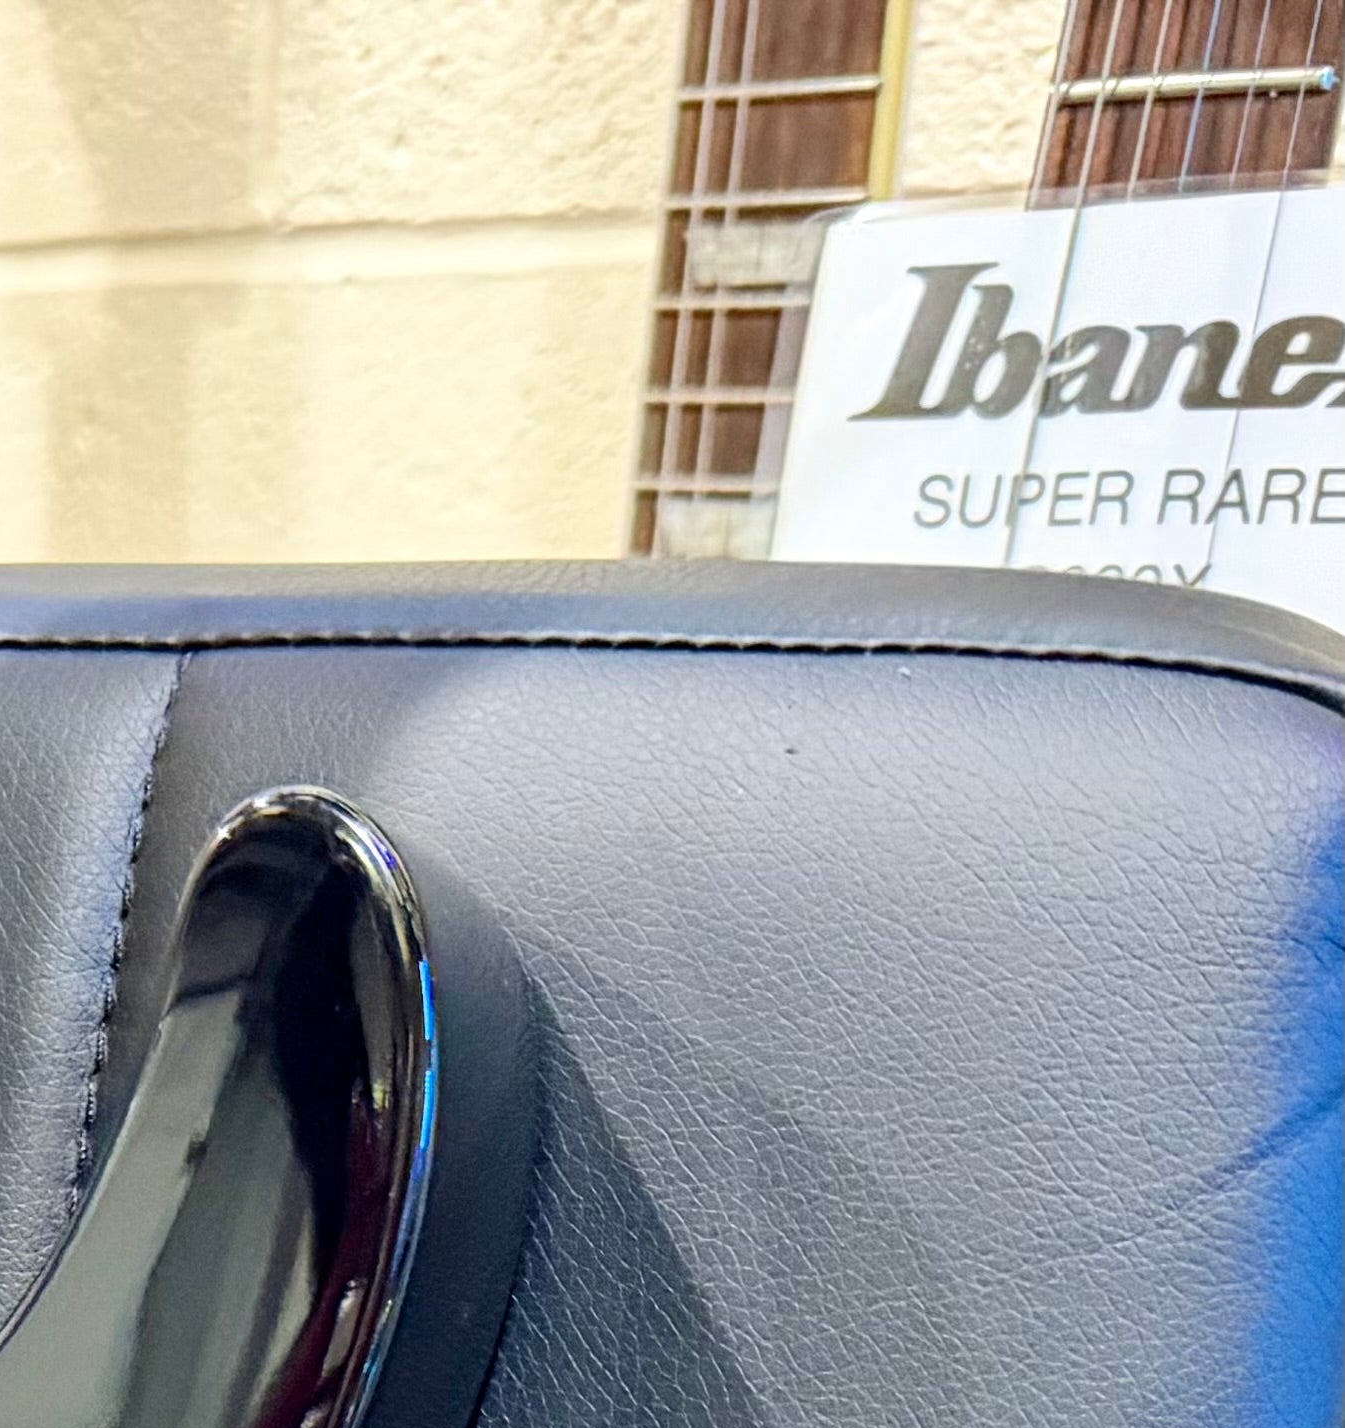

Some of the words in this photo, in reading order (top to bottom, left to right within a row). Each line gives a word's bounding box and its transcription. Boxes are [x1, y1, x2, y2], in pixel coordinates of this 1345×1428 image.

[846, 262, 1345, 422] Ibane
[913, 469, 1135, 529] SUPER
[1157, 467, 1345, 526] RARE
